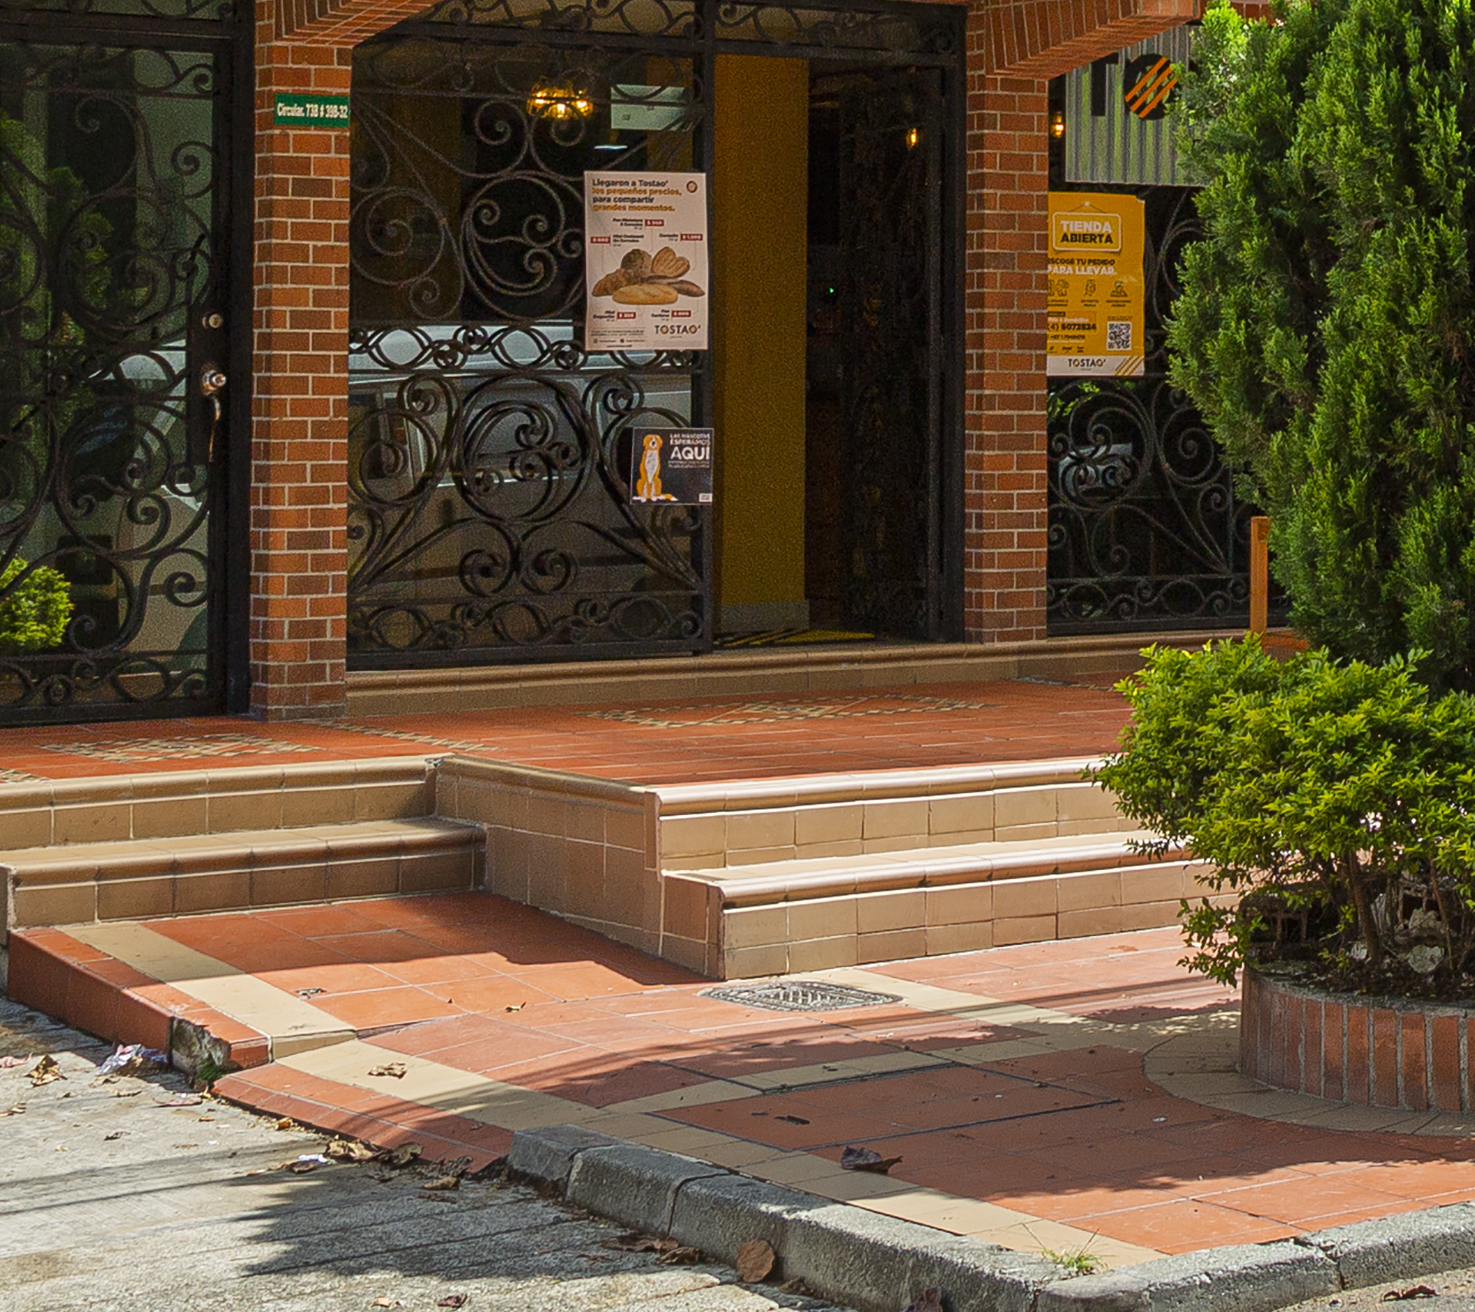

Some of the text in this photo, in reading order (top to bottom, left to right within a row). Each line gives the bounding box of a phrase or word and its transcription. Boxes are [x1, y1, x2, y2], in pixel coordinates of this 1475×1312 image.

[592, 178, 630, 188] Llegaron
[592, 196, 655, 204] para compartir
[1060, 219, 1113, 234] TIENDA
[1060, 233, 1114, 244] ABIERTA
[1076, 257, 1087, 266] TU
[1087, 258, 1116, 266] PEDIDO
[654, 324, 702, 335] TOSTAO'
[1067, 358, 1107, 368] TOSTAO'
